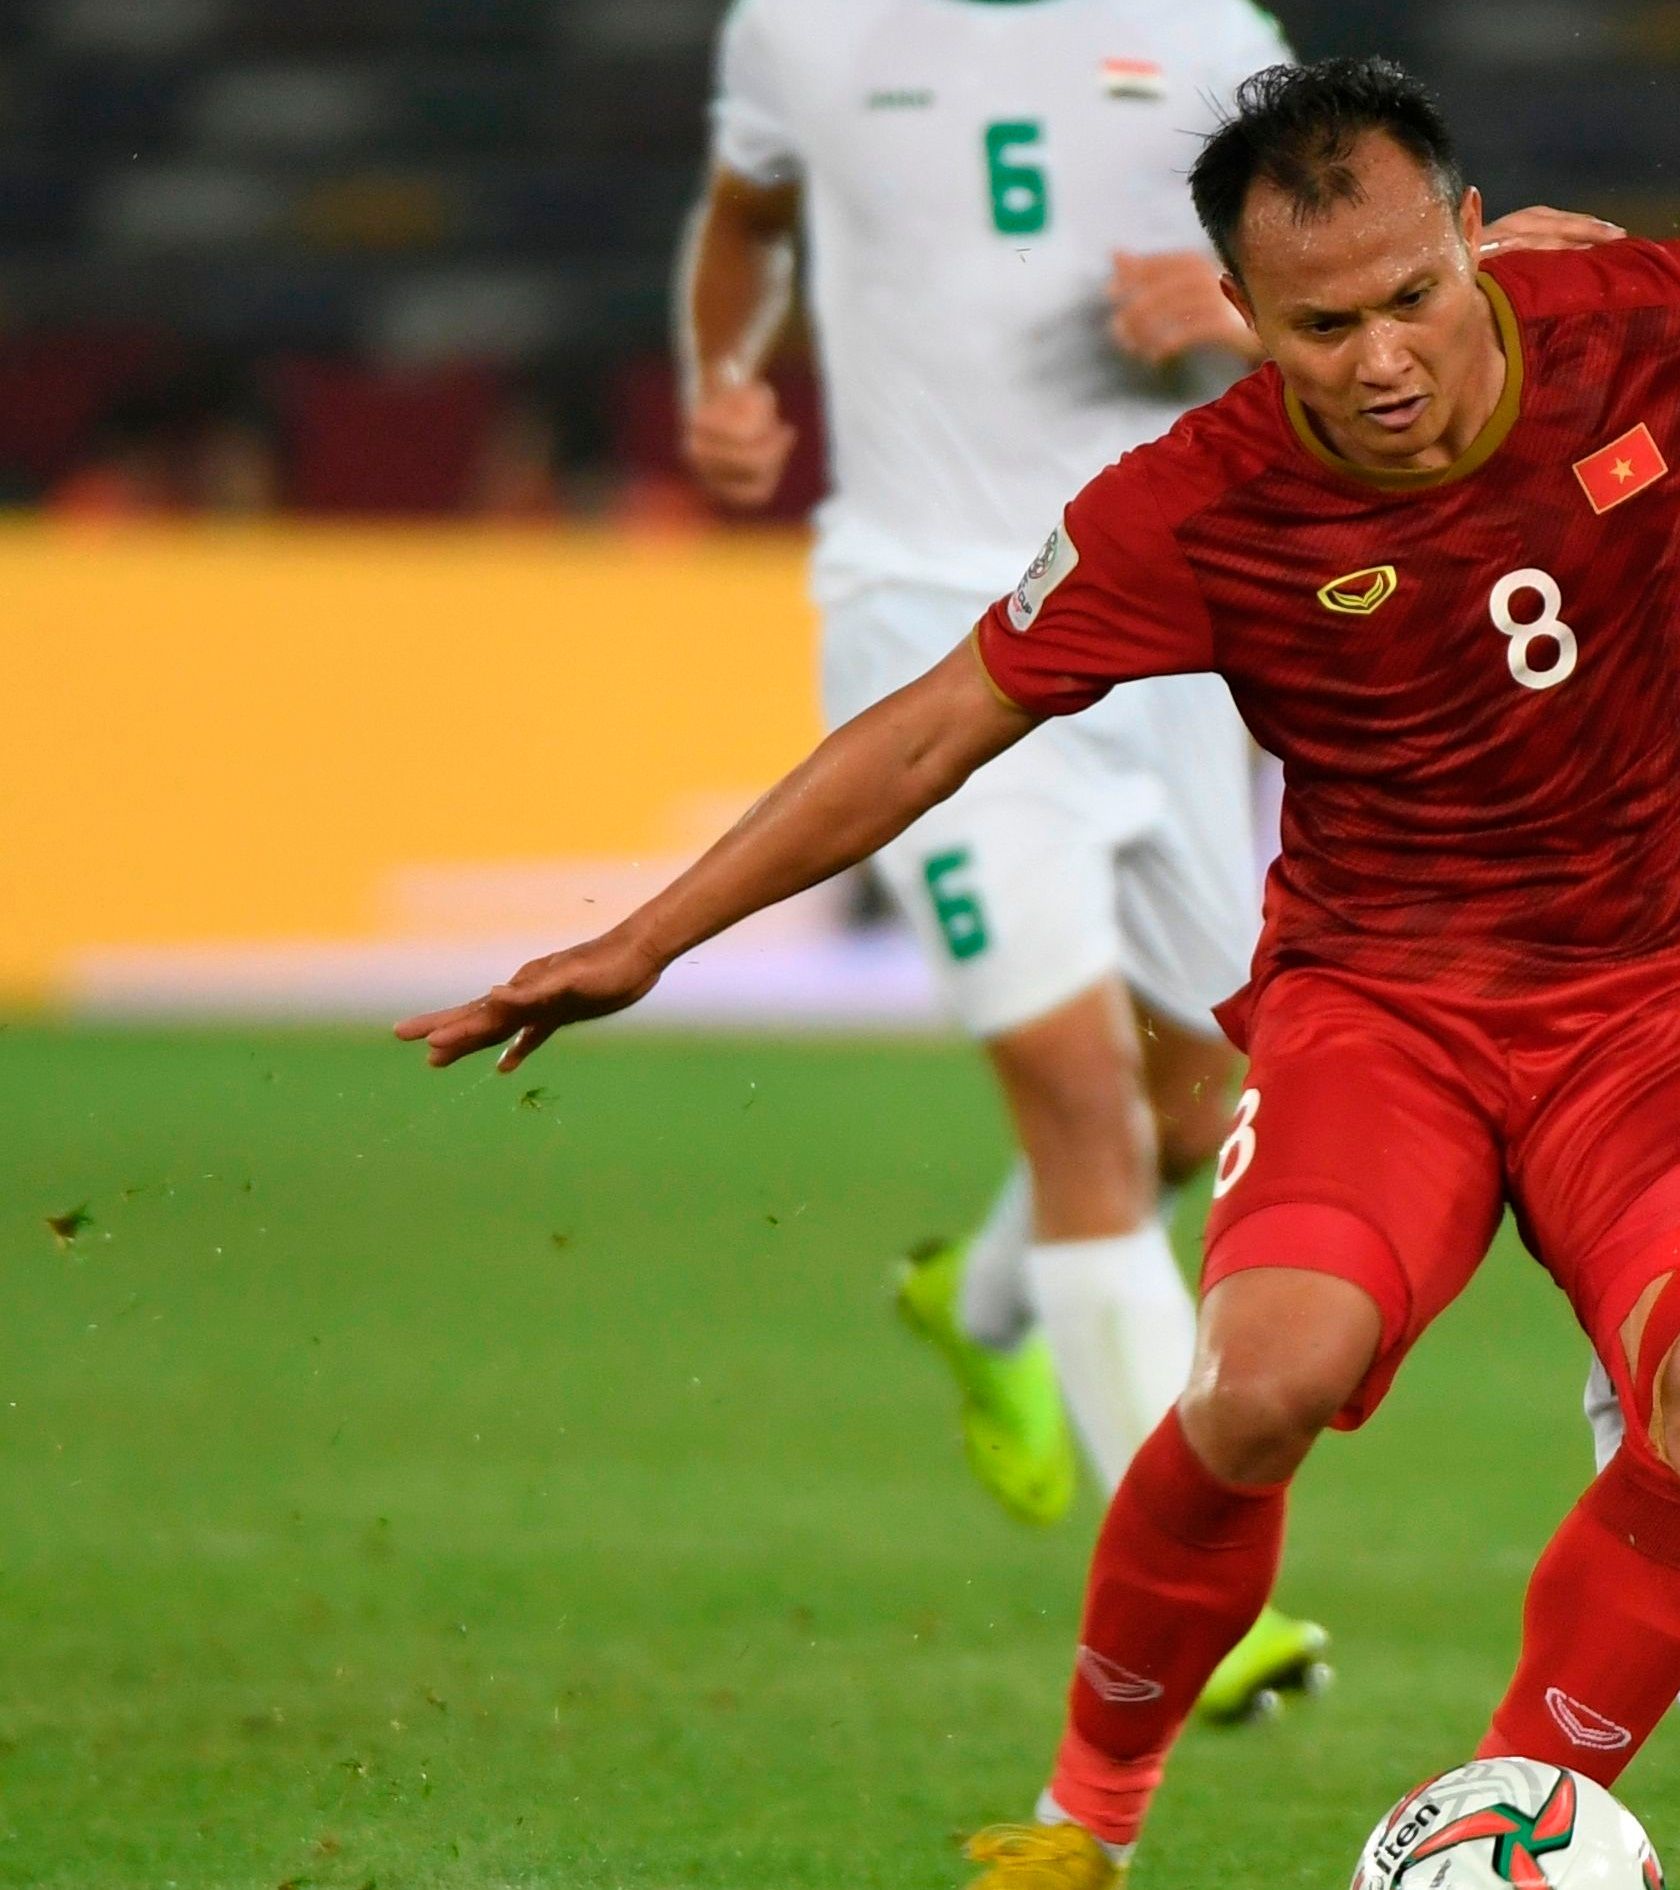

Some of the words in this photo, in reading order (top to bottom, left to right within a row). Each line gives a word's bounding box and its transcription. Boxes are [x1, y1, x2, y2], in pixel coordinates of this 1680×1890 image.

[985, 120, 1049, 234] 6
[1489, 568, 1577, 690] 8
[924, 844, 990, 961] 6
